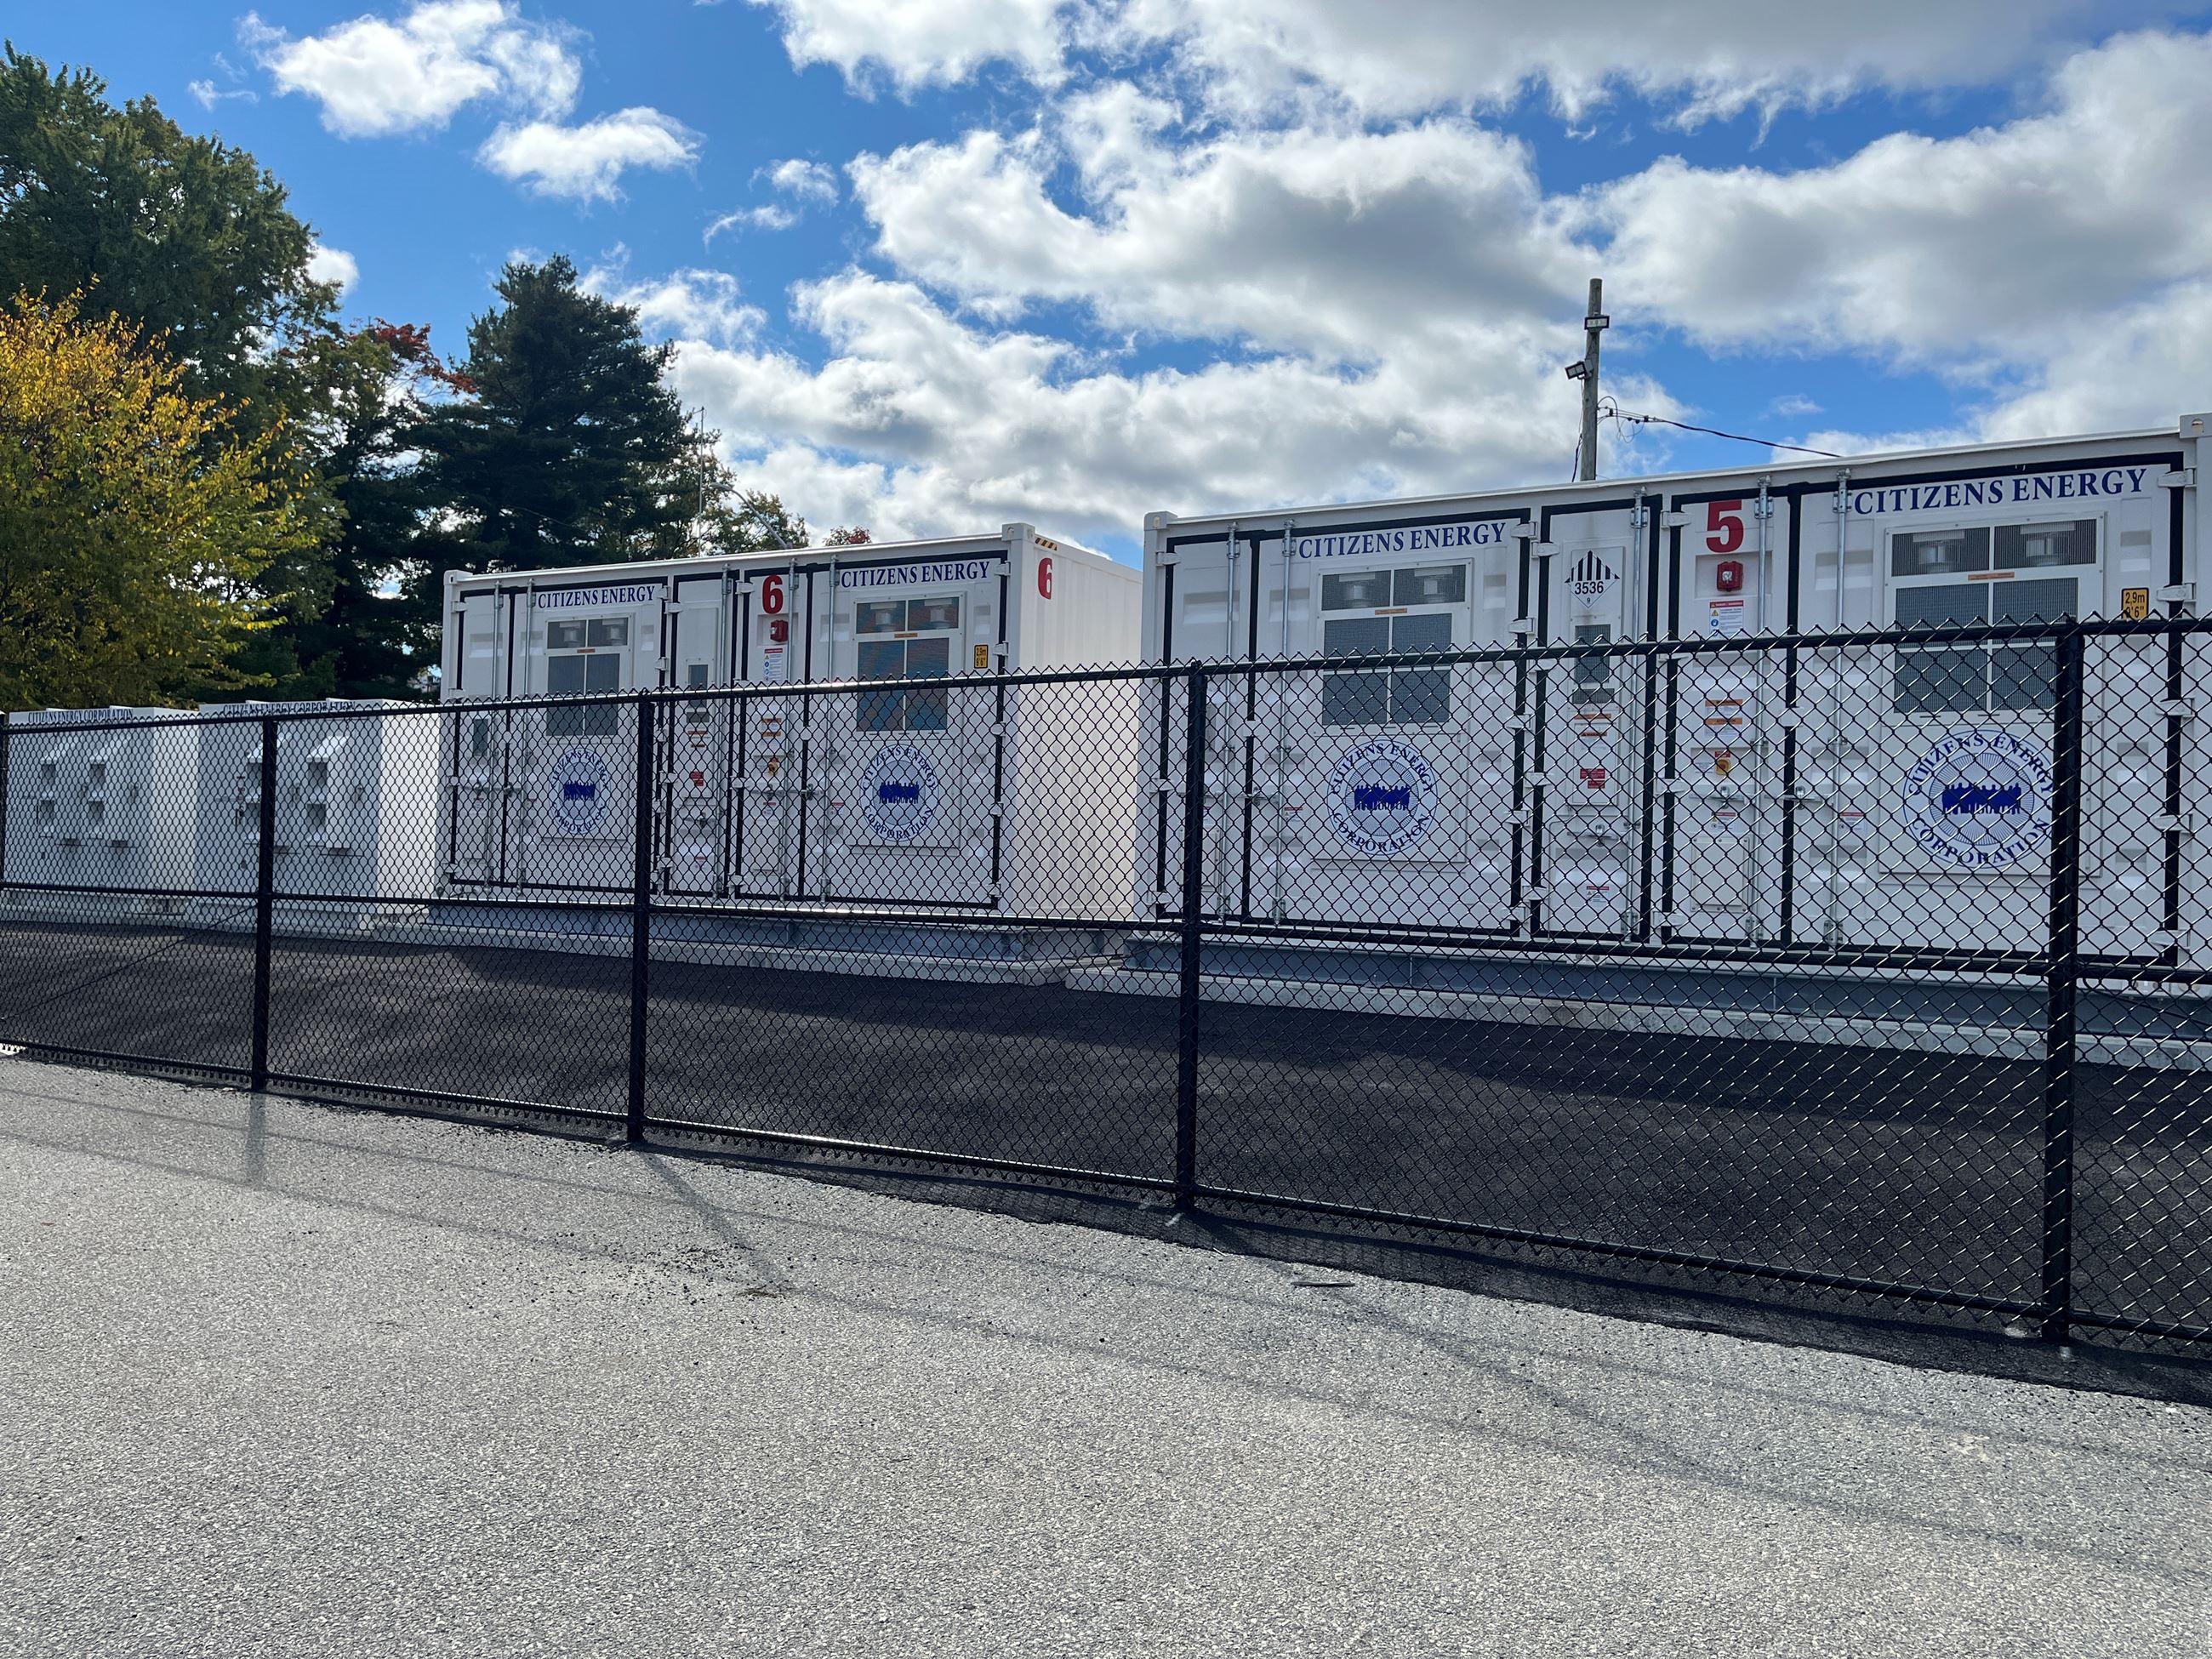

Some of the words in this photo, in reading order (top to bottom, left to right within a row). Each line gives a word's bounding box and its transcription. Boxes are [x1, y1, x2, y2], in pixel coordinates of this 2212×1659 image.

[1854, 479, 2004, 515] CITIZENS
[2011, 468, 2147, 502] ENERGY
[1298, 531, 1405, 559] CITIZENS
[1410, 522, 1507, 550] ENERGY
[1706, 499, 1744, 553] 5
[762, 574, 784, 614] 6
[841, 566, 918, 588] CITIZENS
[921, 561, 990, 583] ENERGY
[1038, 557, 1052, 600] 6
[1574, 580, 1605, 595] 3536
[538, 589, 599, 609] CITIZENS
[601, 585, 656, 604] ENERGY
[28, 710, 57, 723] CITIZENS
[58, 710, 83, 722] ENERGY
[84, 708, 134, 722] CORPORATION
[1332, 743, 1384, 795] CITIZENS
[1389, 743, 1433, 793] ENERGY
[1908, 734, 1984, 796] CITIZENS
[1993, 736, 2053, 794] ENERGY
[1332, 812, 1430, 852] CORPORATION
[1913, 817, 2050, 864] CORPORATION
